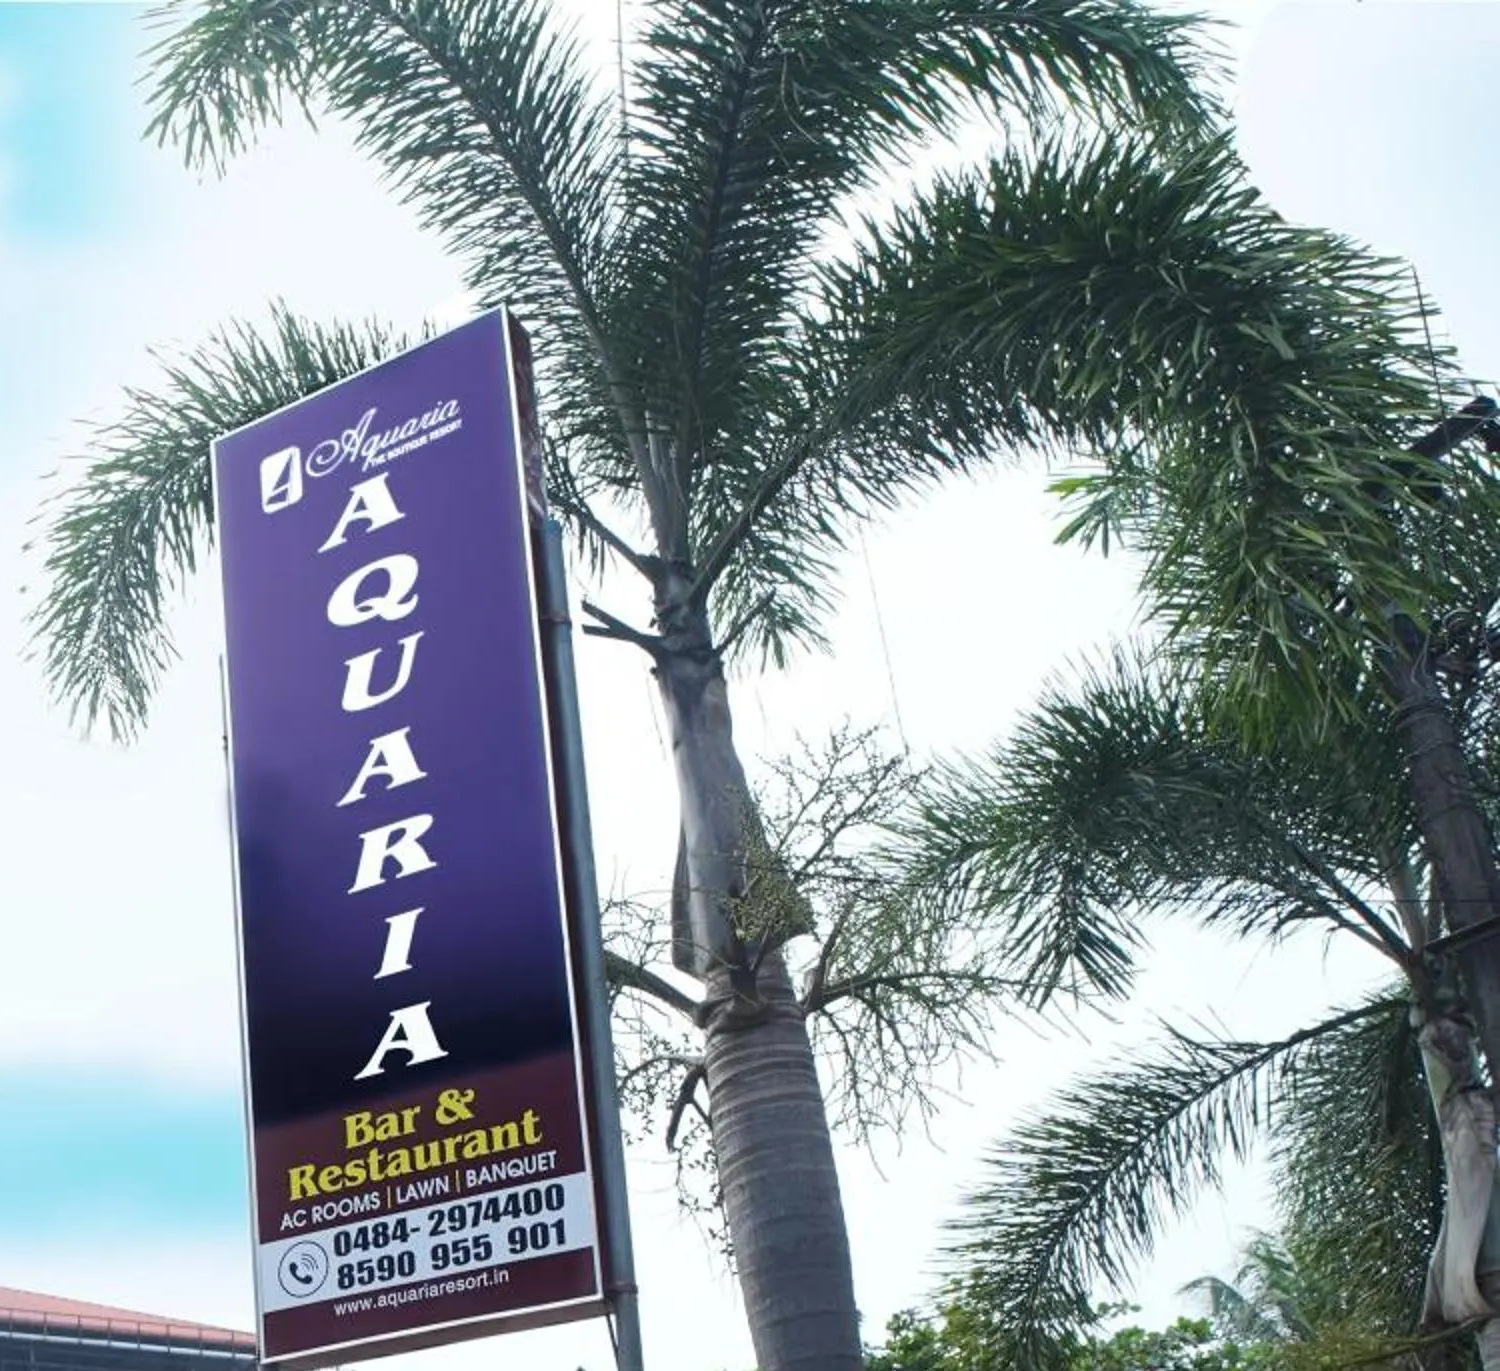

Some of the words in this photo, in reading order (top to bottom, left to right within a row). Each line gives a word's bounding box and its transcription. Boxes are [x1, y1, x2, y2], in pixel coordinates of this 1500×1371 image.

[305, 399, 461, 477] Aquaria
[317, 472, 449, 1081] AQUARIA
[287, 1108, 543, 1201] Restaurant
[343, 1105, 421, 1149] Bar
[435, 1088, 476, 1125] &
[279, 1209, 308, 1232] AC
[311, 1191, 381, 1225] ROOMS
[396, 1175, 449, 1203] LAWN
[465, 1150, 557, 1188] BANQUET
[427, 1183, 566, 1237] 2974400
[337, 1250, 416, 1290] 8590
[430, 1233, 493, 1271] 955
[507, 1218, 567, 1254] 901
[333, 1268, 510, 1317] www.aquariaresort.in
